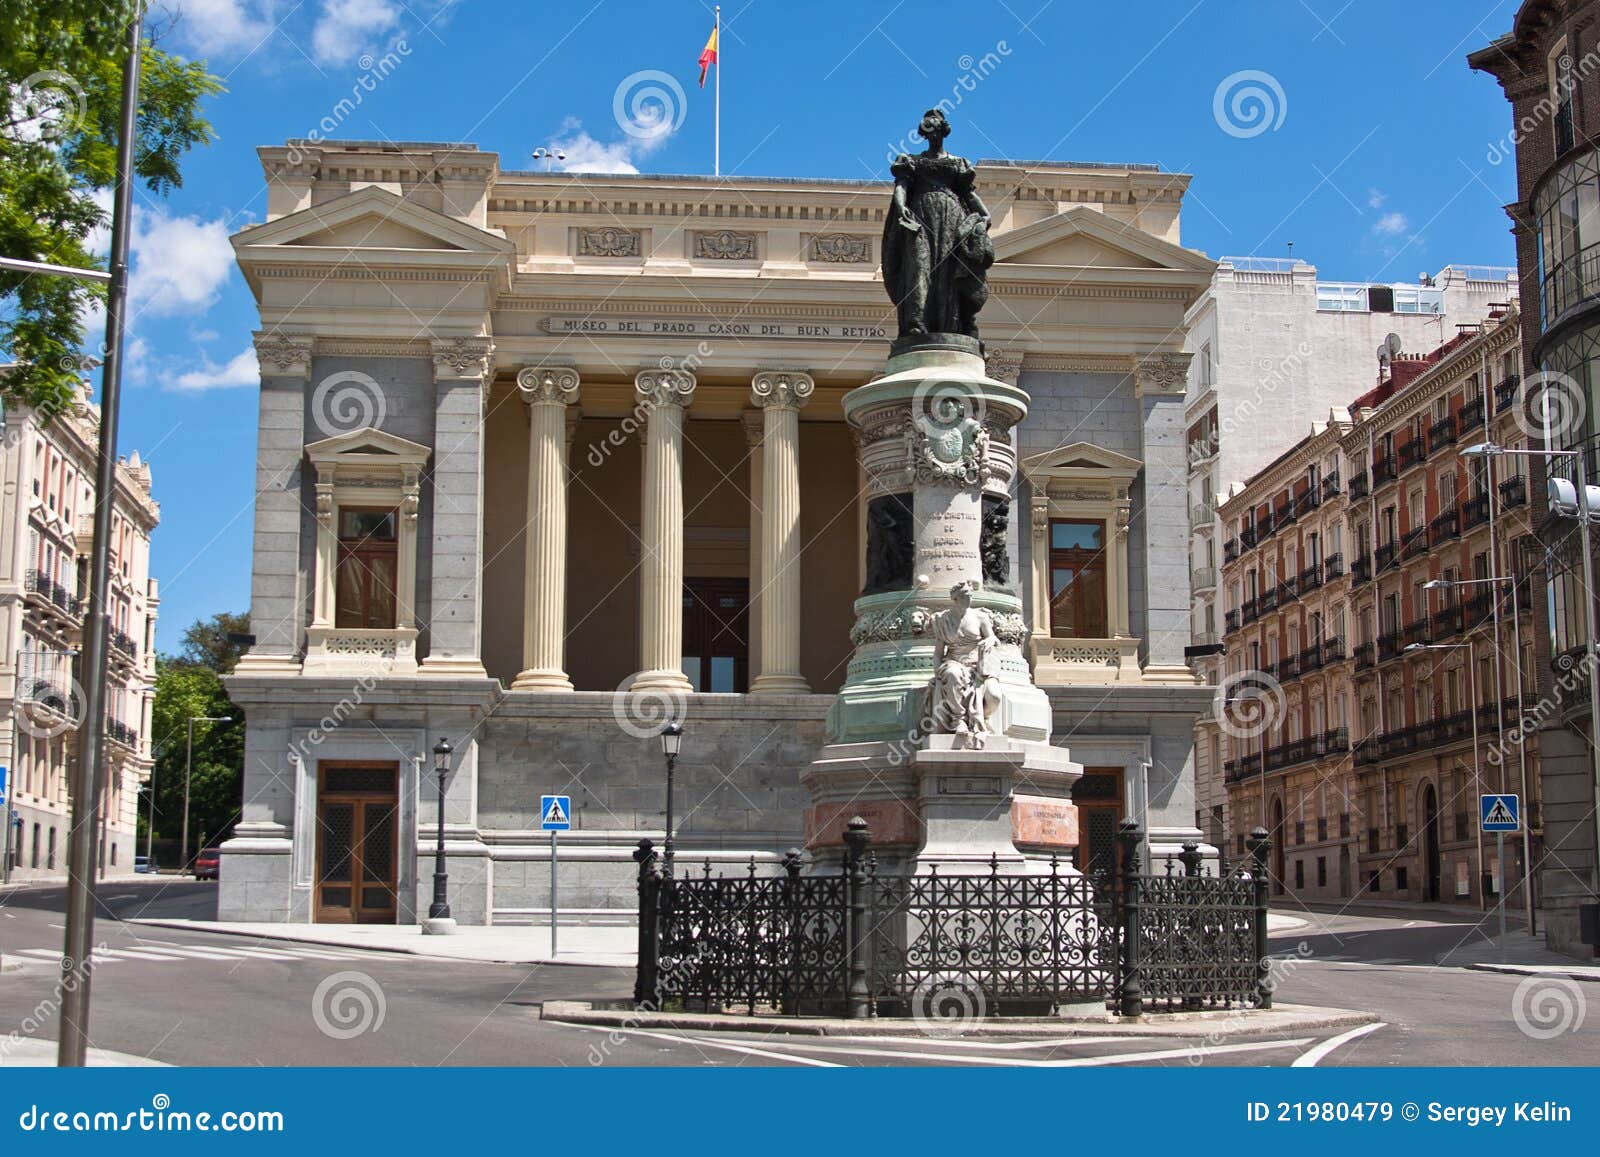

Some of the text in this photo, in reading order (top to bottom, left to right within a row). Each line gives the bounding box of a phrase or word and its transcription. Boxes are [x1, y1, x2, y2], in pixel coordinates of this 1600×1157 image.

[563, 320, 886, 337] MUSEO DEL PRADO CASON DEL BUEN RETIRO
